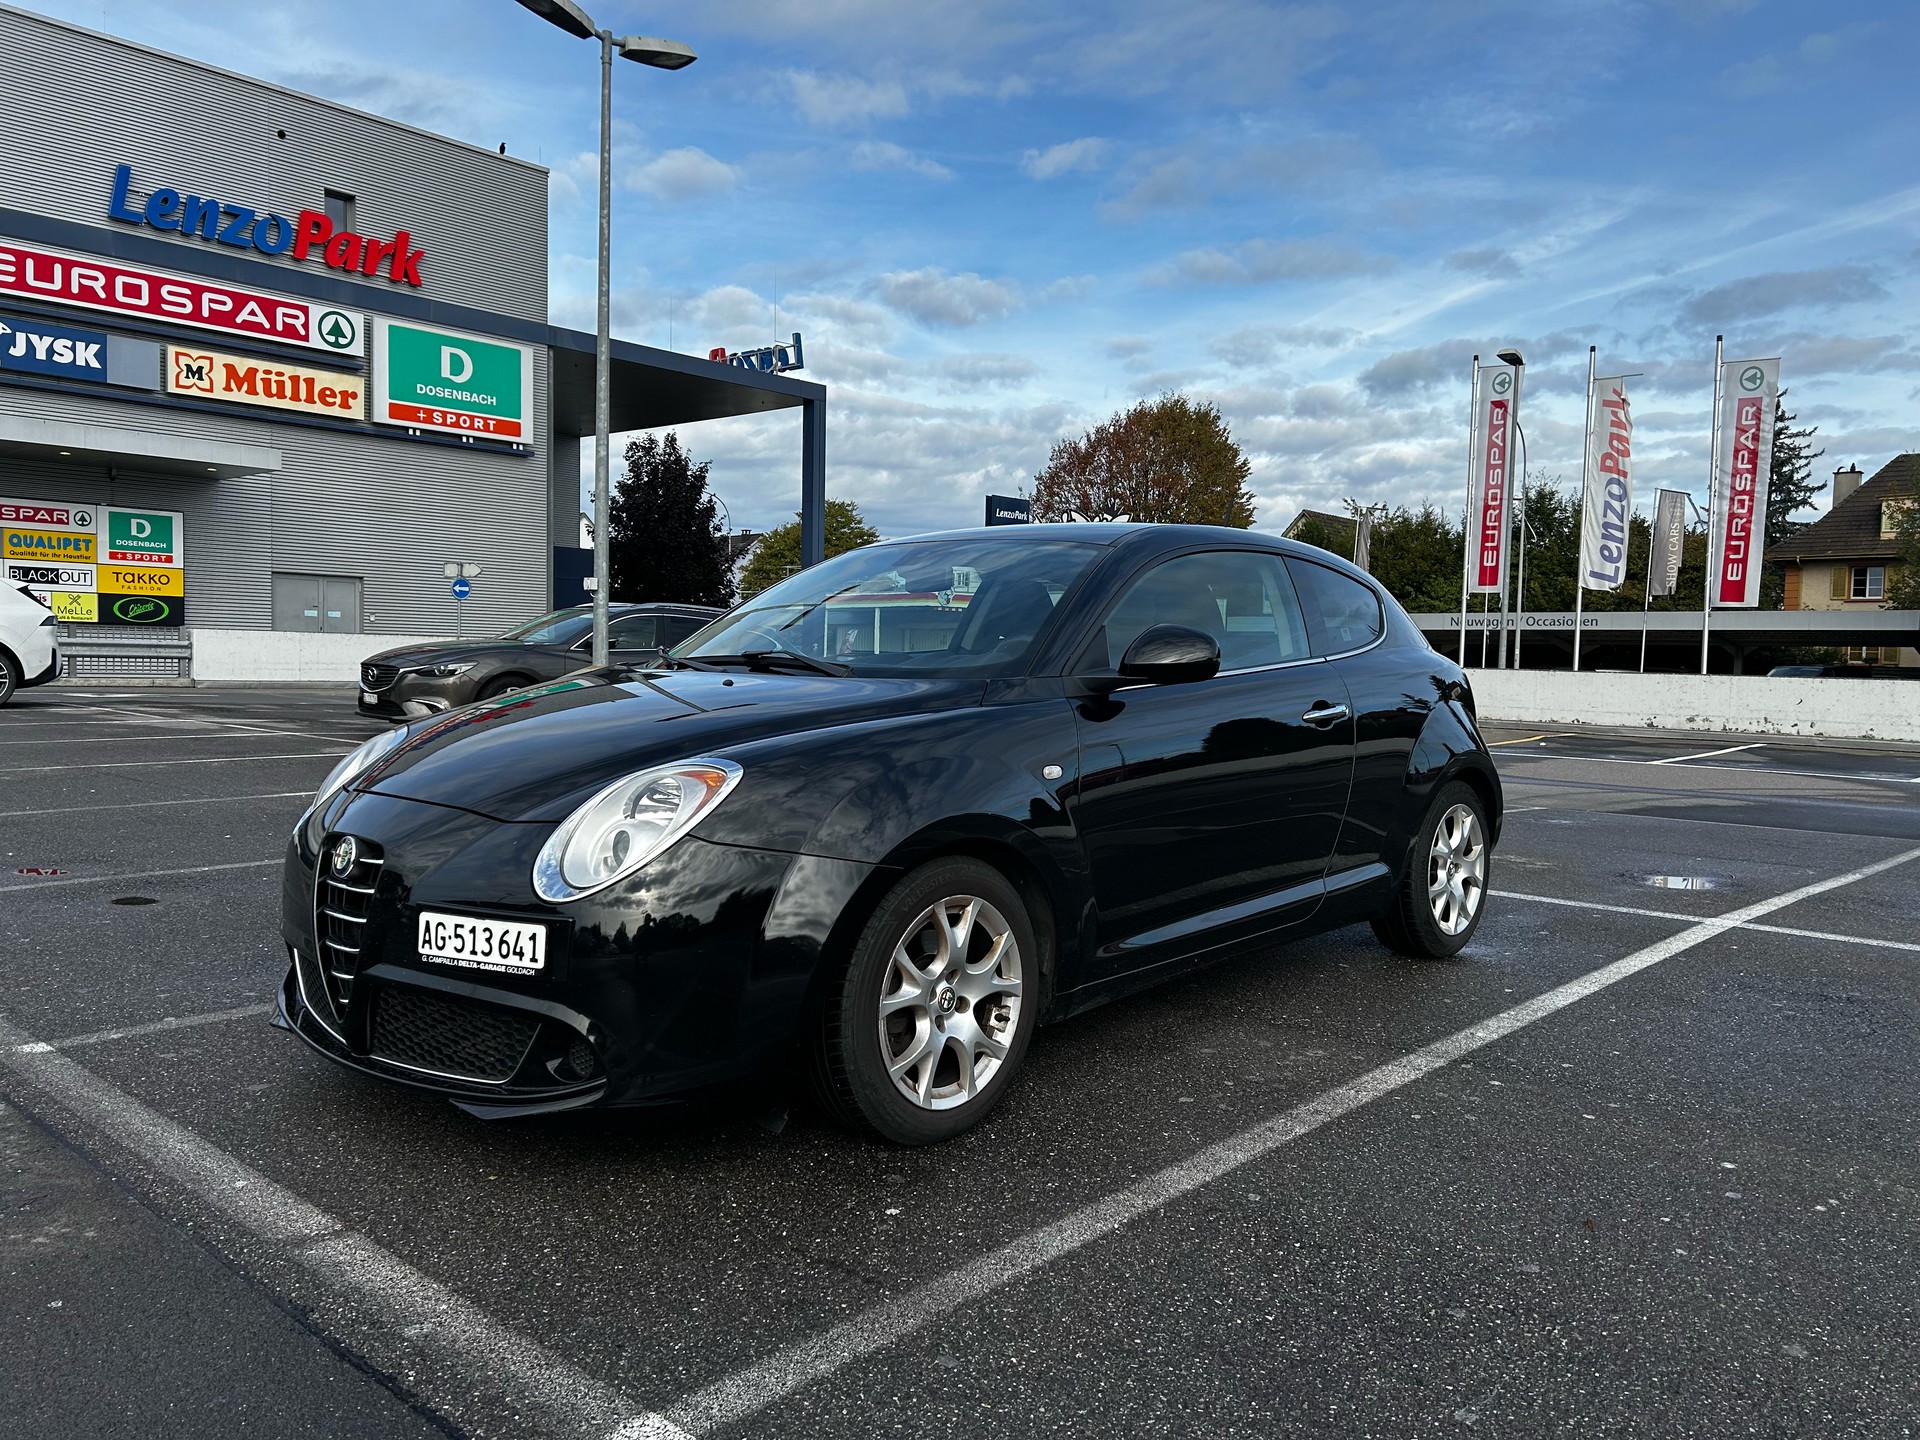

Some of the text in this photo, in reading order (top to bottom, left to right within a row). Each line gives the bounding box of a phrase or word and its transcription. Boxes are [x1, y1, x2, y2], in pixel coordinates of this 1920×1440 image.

[108, 163, 425, 287] LenzoPark
[8, 331, 102, 369] JYSK
[440, 345, 474, 384] D
[222, 361, 358, 410] Müller
[416, 383, 497, 406] DOSENBACH
[432, 411, 497, 432] SPORT
[1483, 407, 1505, 567] EUROSPAR
[1727, 404, 1761, 581] EUROSPAR
[1, 507, 68, 523] SPAR
[996, 508, 1028, 521] LenzoPark
[130, 518, 152, 538] D
[1669, 522, 1680, 551] CARS
[9, 533, 92, 552] QUALIPET
[116, 539, 167, 549] DOSENBACH
[126, 553, 167, 562] SPORT
[10, 568, 90, 583] BLACKOUT
[1666, 553, 1678, 588] SHOW
[1450, 616, 1514, 629] Nuwagn
[506, 967, 536, 976] GOLDACH
